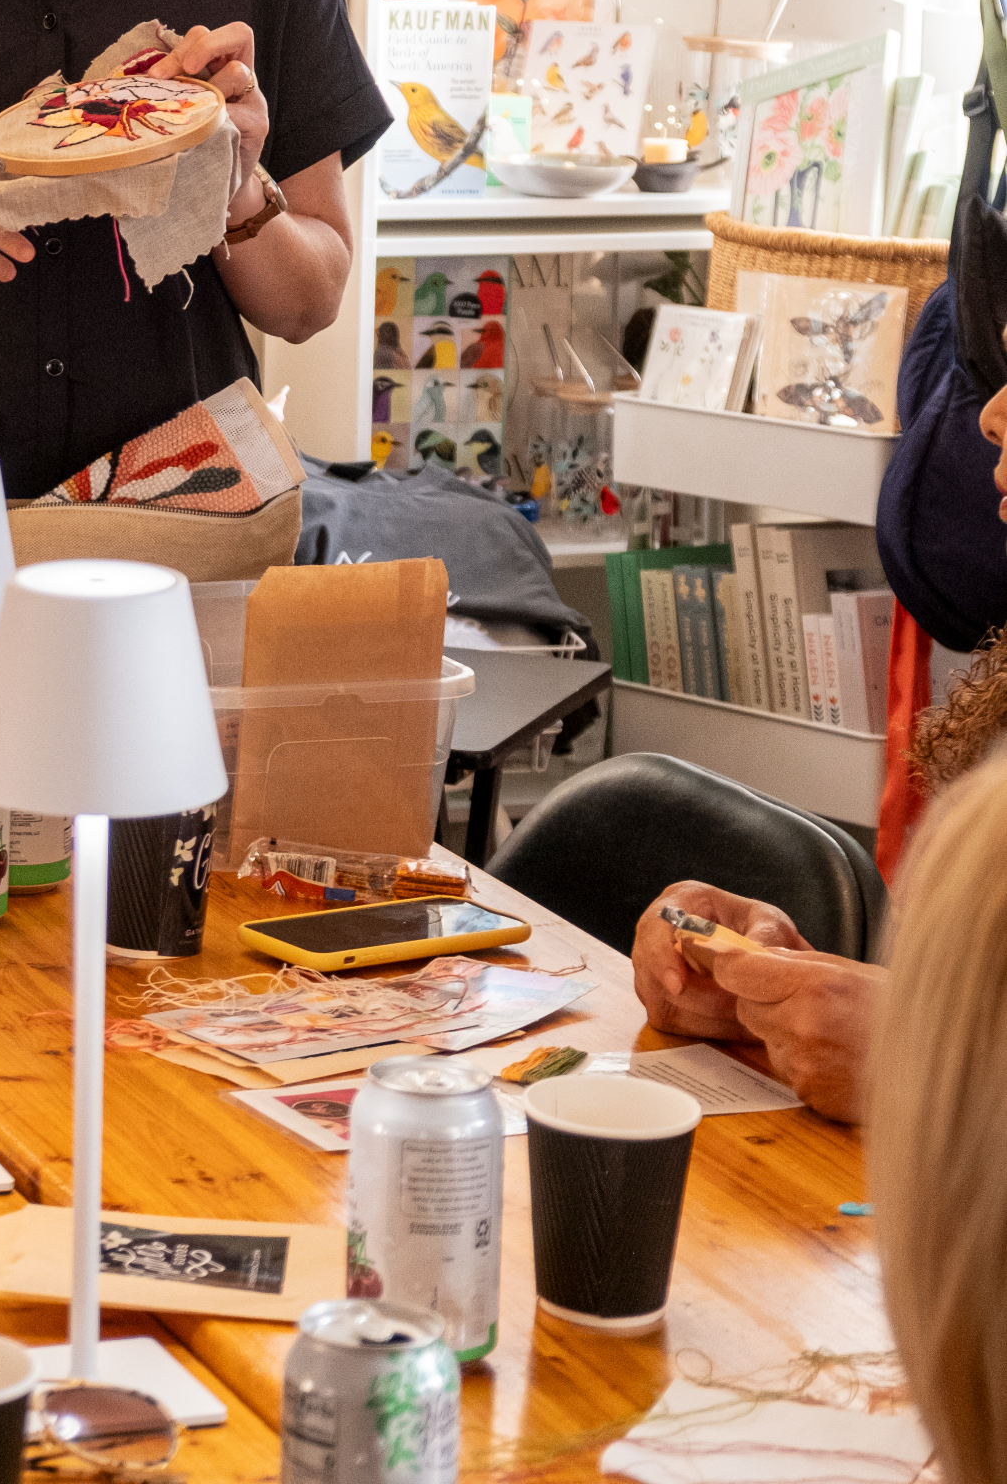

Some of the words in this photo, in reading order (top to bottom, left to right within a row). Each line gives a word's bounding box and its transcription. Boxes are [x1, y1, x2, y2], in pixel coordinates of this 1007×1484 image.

[388, 9, 490, 31] KAUFMAN
[388, 33, 416, 45] Field
[419, 34, 453, 45] Guide
[456, 35, 468, 45] to
[388, 46, 416, 58] Birds
[418, 46, 431, 60] of
[388, 59, 420, 71] North
[424, 60, 473, 72] America
[745, 589, 758, 650] Simplicity
[754, 669, 763, 706] Home
[769, 591, 783, 652] Simplicity
[778, 672, 788, 709] Home
[783, 596, 797, 657] Simplicity
[792, 677, 802, 714] Home
[806, 631, 820, 687] NIKSEN
[823, 634, 838, 689] NIKSEN
